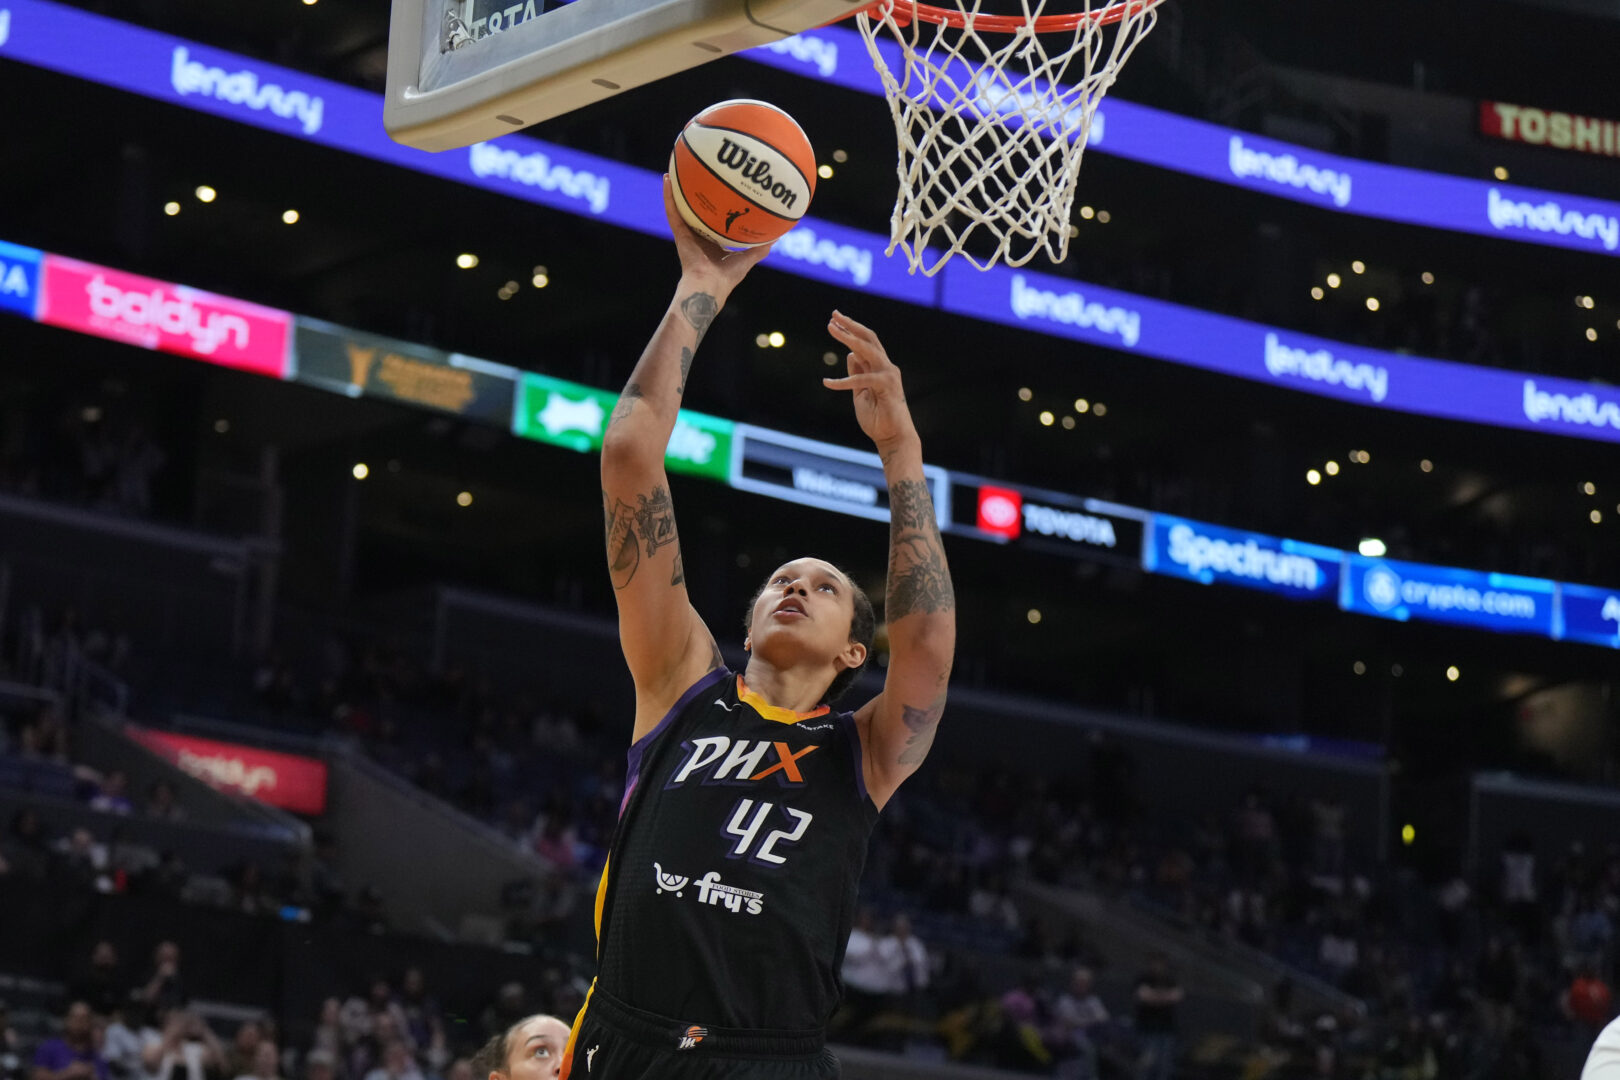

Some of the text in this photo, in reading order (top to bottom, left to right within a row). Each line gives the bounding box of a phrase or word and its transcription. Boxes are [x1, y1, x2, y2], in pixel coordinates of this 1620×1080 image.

[1494, 102, 1620, 158] TOSHI
[717, 137, 797, 210] Wilson
[1022, 503, 1116, 547] TOYOTA
[1168, 523, 1319, 591] Spectrum
[1401, 579, 1536, 619] crypto.com
[672, 736, 820, 784] PHX
[723, 798, 813, 866] 42
[693, 871, 764, 915] fry's
